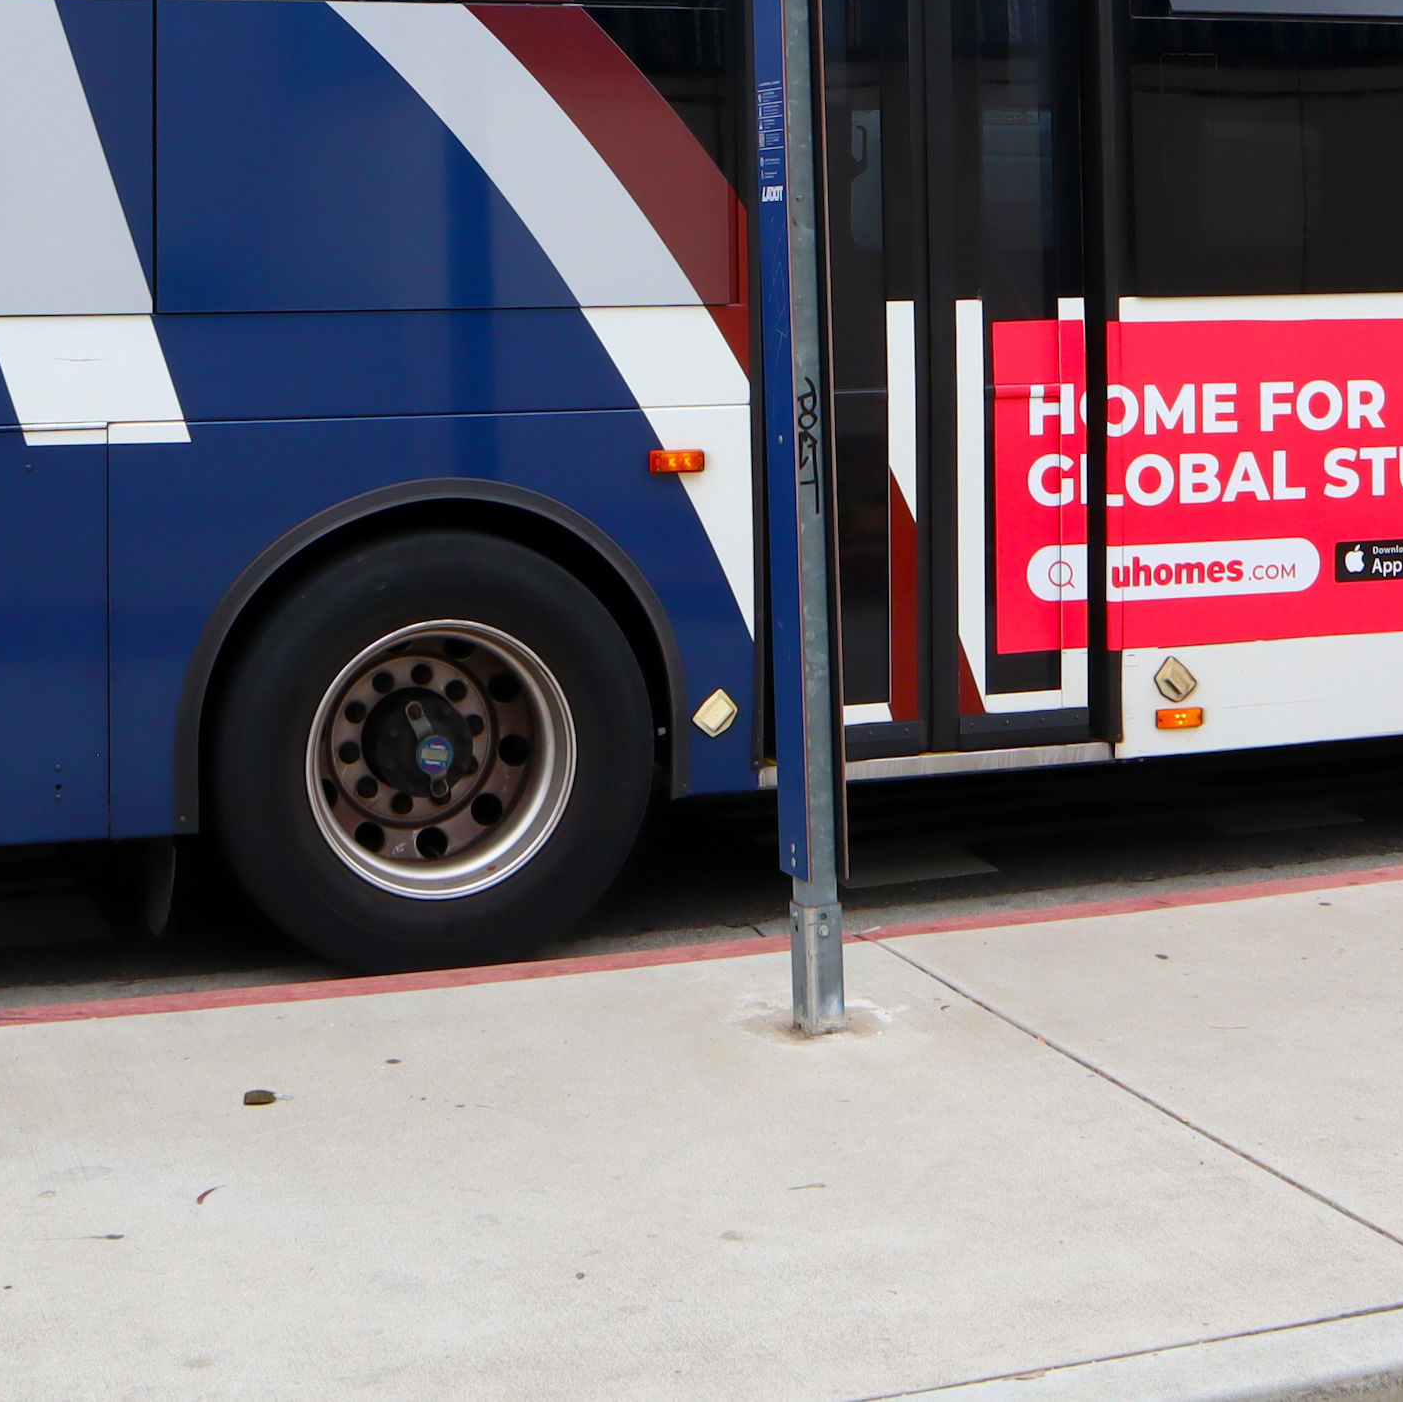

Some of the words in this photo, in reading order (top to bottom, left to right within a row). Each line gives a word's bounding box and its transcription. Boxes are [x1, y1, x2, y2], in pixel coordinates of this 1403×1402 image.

[1029, 383, 1238, 437] HOME
[1260, 379, 1386, 432] FOR
[1027, 450, 1307, 507] GLOBAL
[1371, 557, 1403, 577] App
